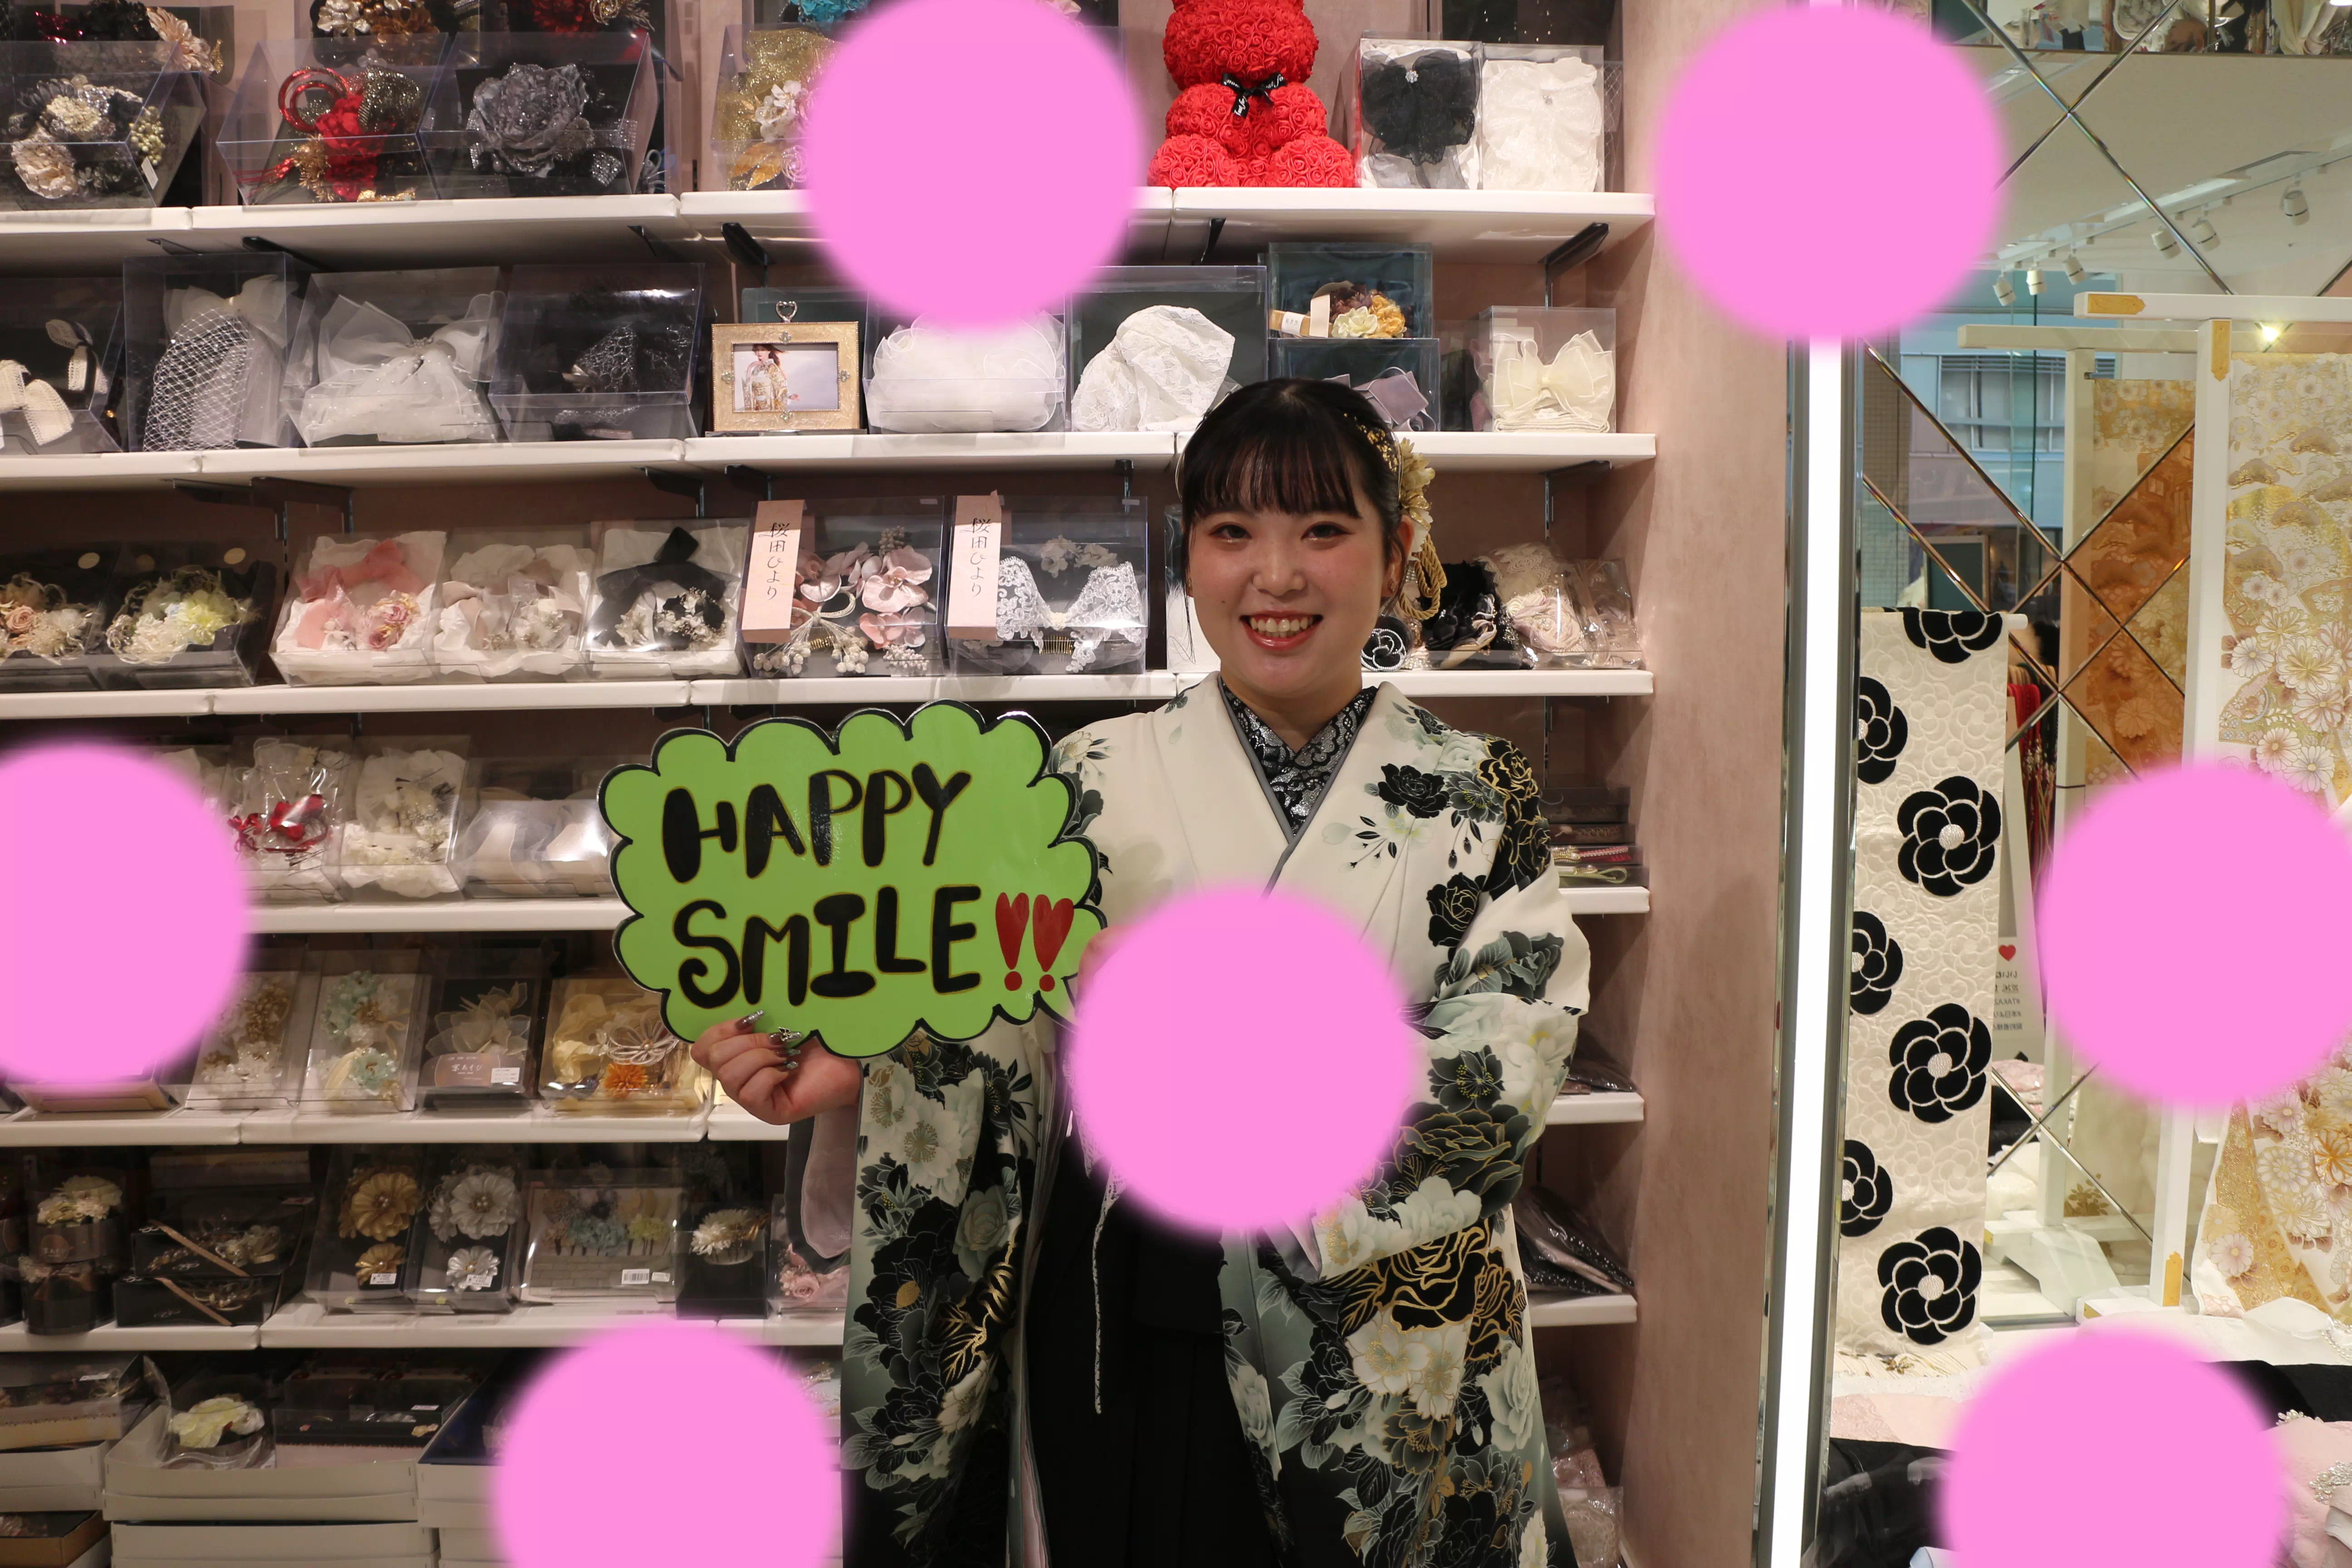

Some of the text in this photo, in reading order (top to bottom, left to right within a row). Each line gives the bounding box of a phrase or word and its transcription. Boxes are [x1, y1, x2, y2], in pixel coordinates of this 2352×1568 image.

[758, 522, 790, 601] 桜田ひより
[959, 517, 991, 598] 桜田ひより
[661, 761, 971, 883] HAPPY
